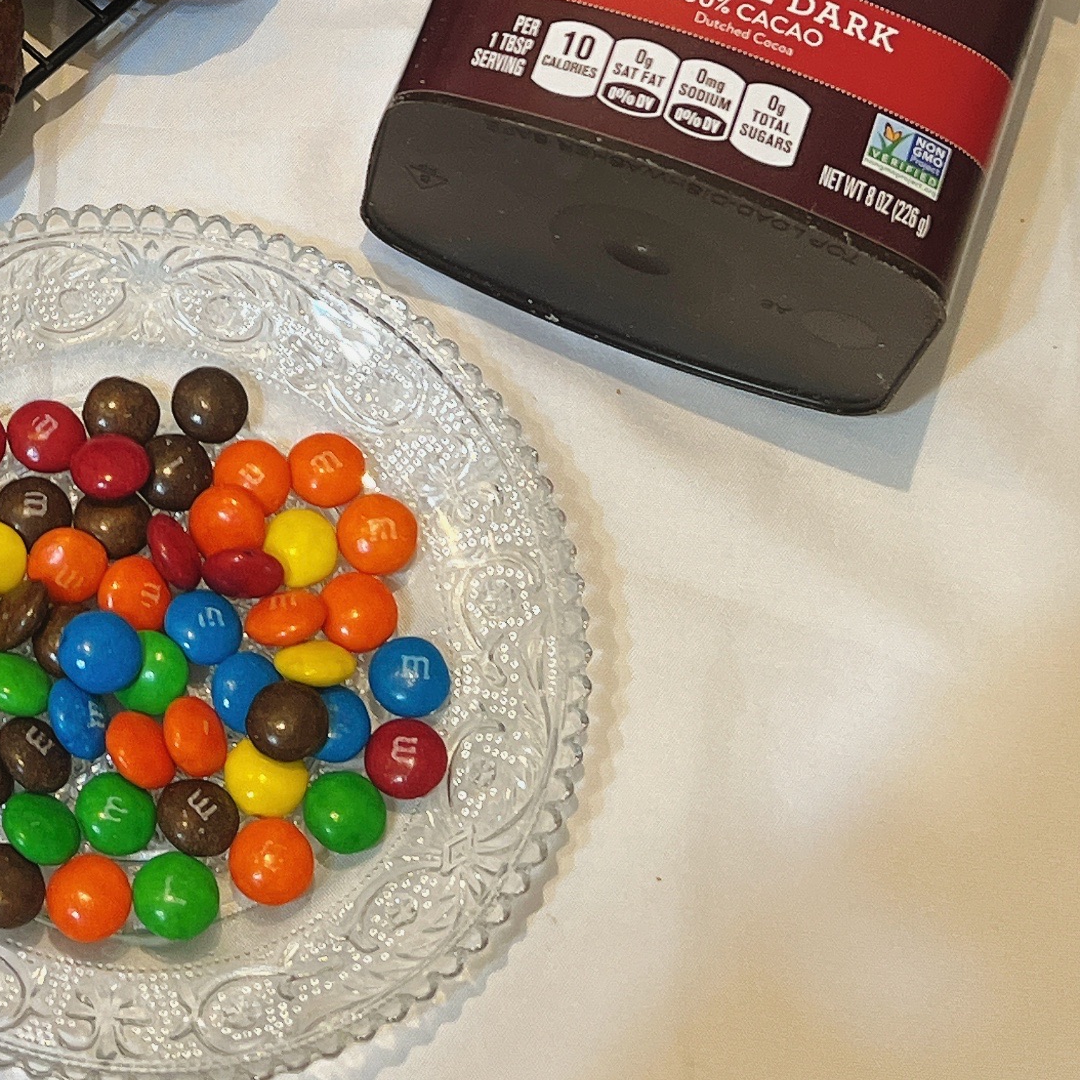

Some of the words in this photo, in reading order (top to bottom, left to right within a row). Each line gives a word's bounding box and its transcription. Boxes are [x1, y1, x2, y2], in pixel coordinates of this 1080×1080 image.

[512, 14, 542, 37] PER
[694, 10, 752, 40] Dutched
[753, 31, 795, 58] Cocoa
[736, 3, 824, 48] CACAO
[488, 31, 499, 48] 1
[499, 32, 535, 56] TBSP
[562, 31, 596, 61] 10
[470, 47, 528, 77] SERVING
[541, 54, 598, 80] CALORIES
[635, 49, 654, 70] 0g
[612, 62, 639, 80] SAT
[640, 71, 666, 88] FAT
[696, 68, 726, 94] 0mg
[678, 83, 732, 112] SODIUM
[767, 95, 787, 118] 0g
[752, 109, 791, 136] TOTAL
[739, 123, 794, 154] SUGARS
[916, 136, 947, 159] NON
[912, 146, 944, 169] GMO
[818, 164, 845, 192] NET
[842, 175, 868, 202] WT
[864, 186, 877, 207] 8
[874, 191, 895, 215] OZ
[890, 198, 921, 229] (226
[915, 214, 932, 239] g)
